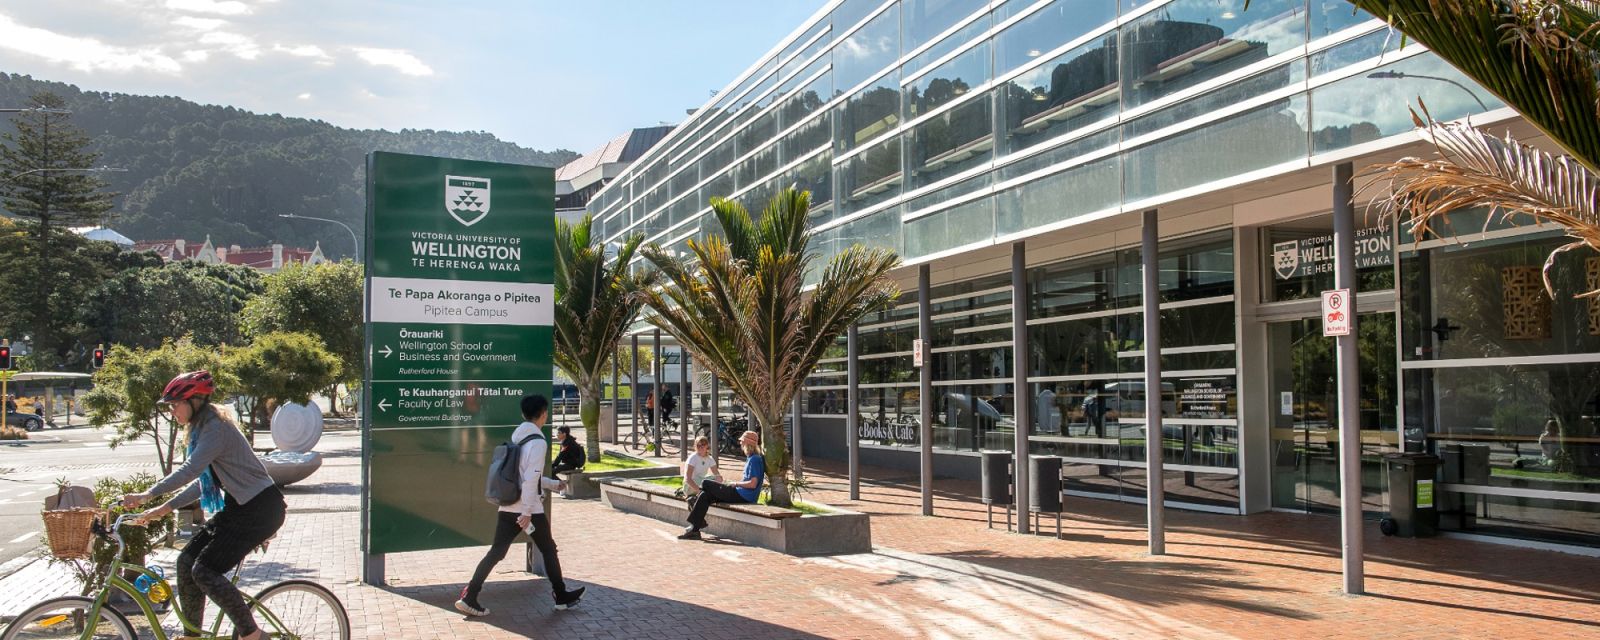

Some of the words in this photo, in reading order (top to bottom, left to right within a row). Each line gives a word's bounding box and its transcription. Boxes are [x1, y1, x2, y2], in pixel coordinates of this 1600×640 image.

[411, 231, 453, 241] VICTORIA
[456, 234, 507, 244] UNIVERSITY
[509, 237, 521, 245] OF
[1301, 236, 1333, 247] VICTORIA
[411, 241, 521, 261] WELLINGTON
[411, 258, 425, 267] TE
[430, 259, 485, 270] HERENGA
[489, 262, 521, 272] WAKA
[1302, 265, 1312, 276] TE
[1362, 254, 1391, 267] WAKA
[388, 288, 402, 299] Te
[405, 289, 434, 301] Papa
[437, 290, 491, 303] Akoranga
[494, 294, 502, 302] o
[504, 292, 541, 305] Pipitea
[424, 305, 462, 317] Pipitea
[465, 306, 509, 318] Campus
[399, 328, 444, 339] Ōrauariki
[399, 341, 448, 351] Wellington
[450, 341, 481, 350] School
[483, 342, 493, 350] of
[399, 352, 441, 361] Business
[443, 353, 460, 361] and
[462, 353, 517, 362] Government
[399, 367, 436, 375] Rutherford
[399, 388, 411, 397] Te
[412, 388, 475, 398] Kauhanganui
[478, 388, 501, 396] Tātai
[503, 388, 523, 396] Ture
[398, 399, 430, 410] Faculty
[434, 399, 444, 408] of
[445, 399, 464, 408] Law
[441, 414, 473, 422] Buildings
[863, 421, 887, 439] Books
[887, 422, 894, 439] &
